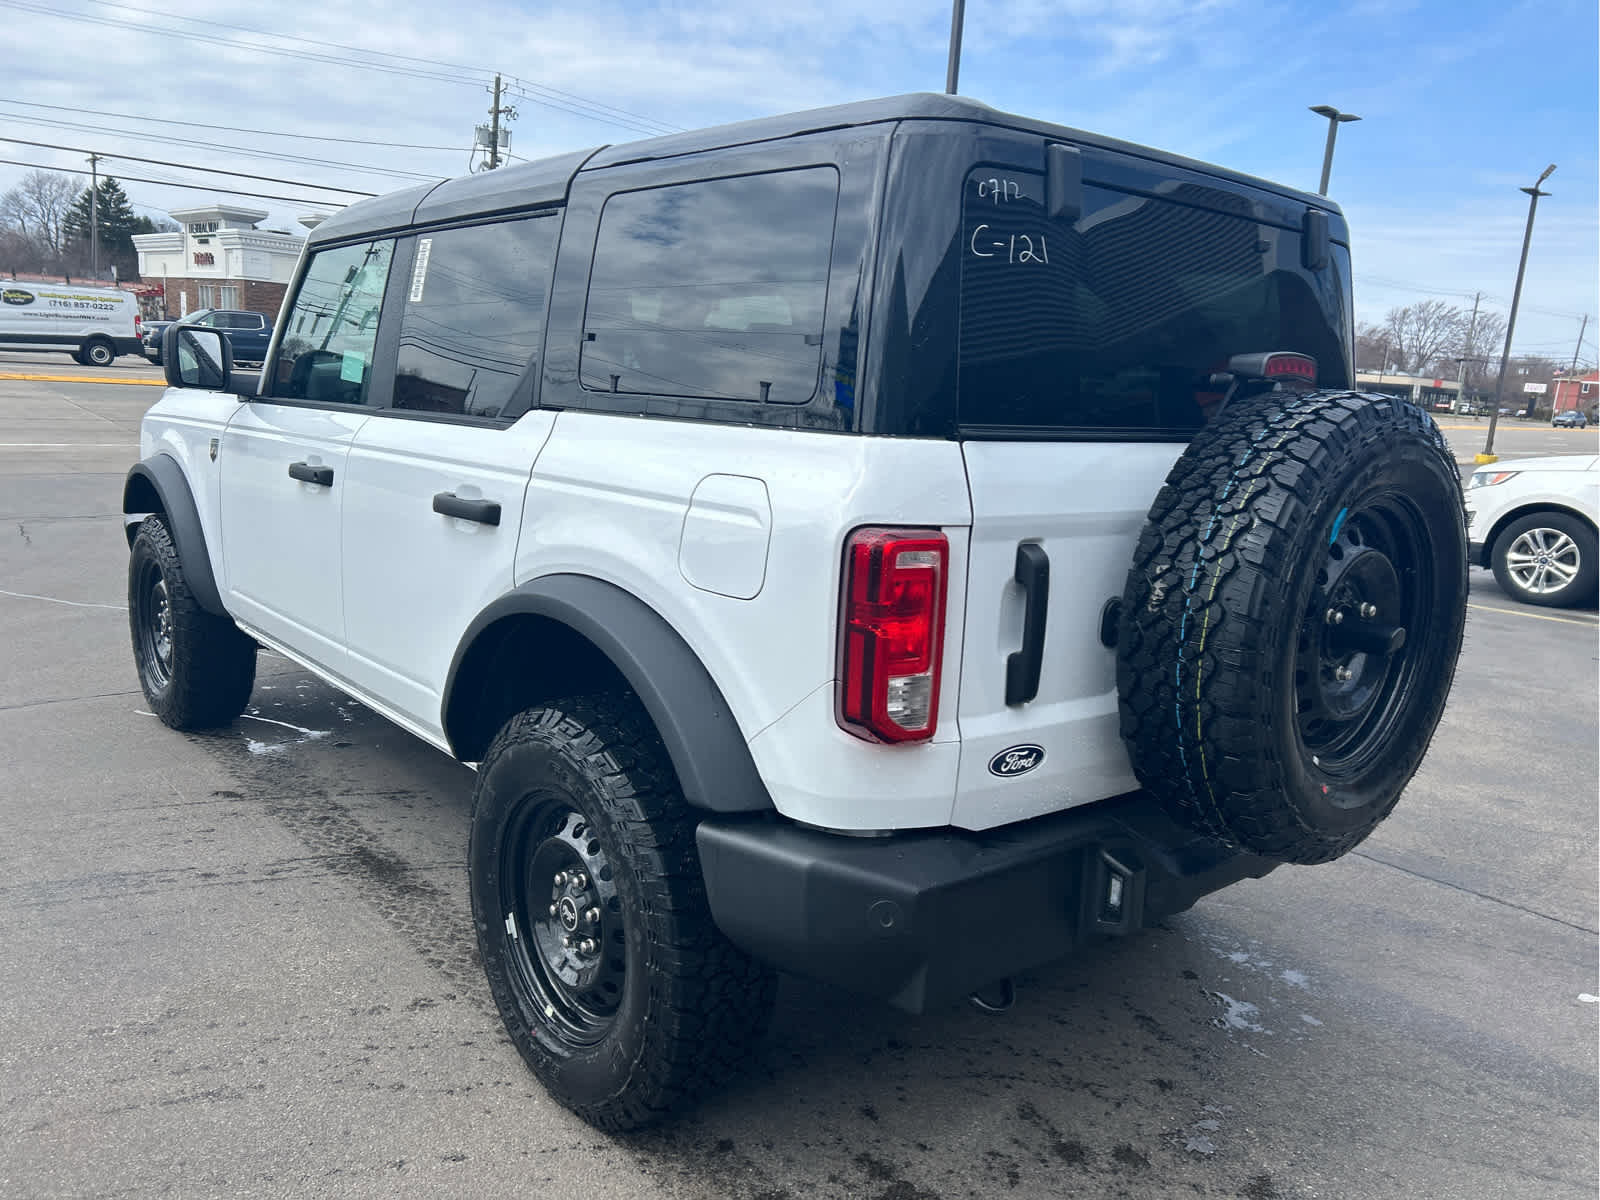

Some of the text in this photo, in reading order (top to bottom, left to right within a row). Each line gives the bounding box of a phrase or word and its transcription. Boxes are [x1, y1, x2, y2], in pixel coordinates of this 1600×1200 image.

[978, 178, 1026, 205] 0712
[971, 224, 1049, 264] C-121
[48, 300, 114, 311] (716) 857-0222
[1000, 750, 1037, 772] Ford
